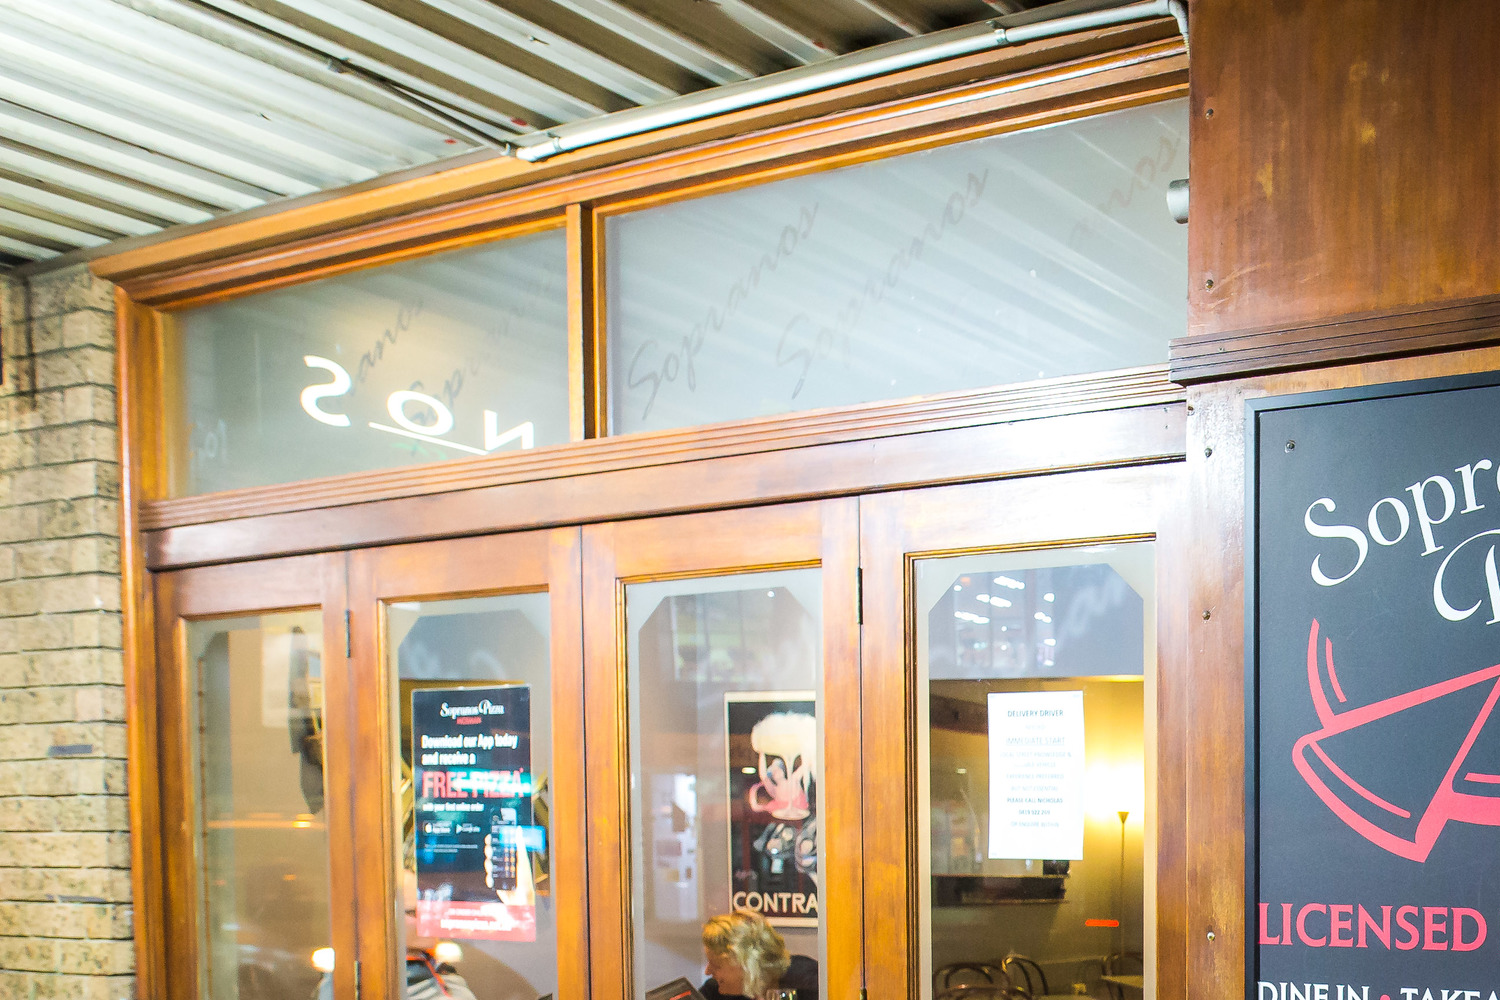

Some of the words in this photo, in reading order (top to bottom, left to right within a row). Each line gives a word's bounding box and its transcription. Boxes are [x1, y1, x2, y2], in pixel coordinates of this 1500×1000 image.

[627, 202, 819, 421] Sopranos
[1007, 710, 1038, 718] DELIVERY
[1040, 709, 1064, 717] DRIVER
[421, 734, 463, 749] Download
[478, 733, 494, 750] App
[495, 733, 518, 749] today
[422, 770, 468, 799] FREE
[733, 891, 818, 914] CONTRA
[1257, 902, 1487, 952] LICENSED
